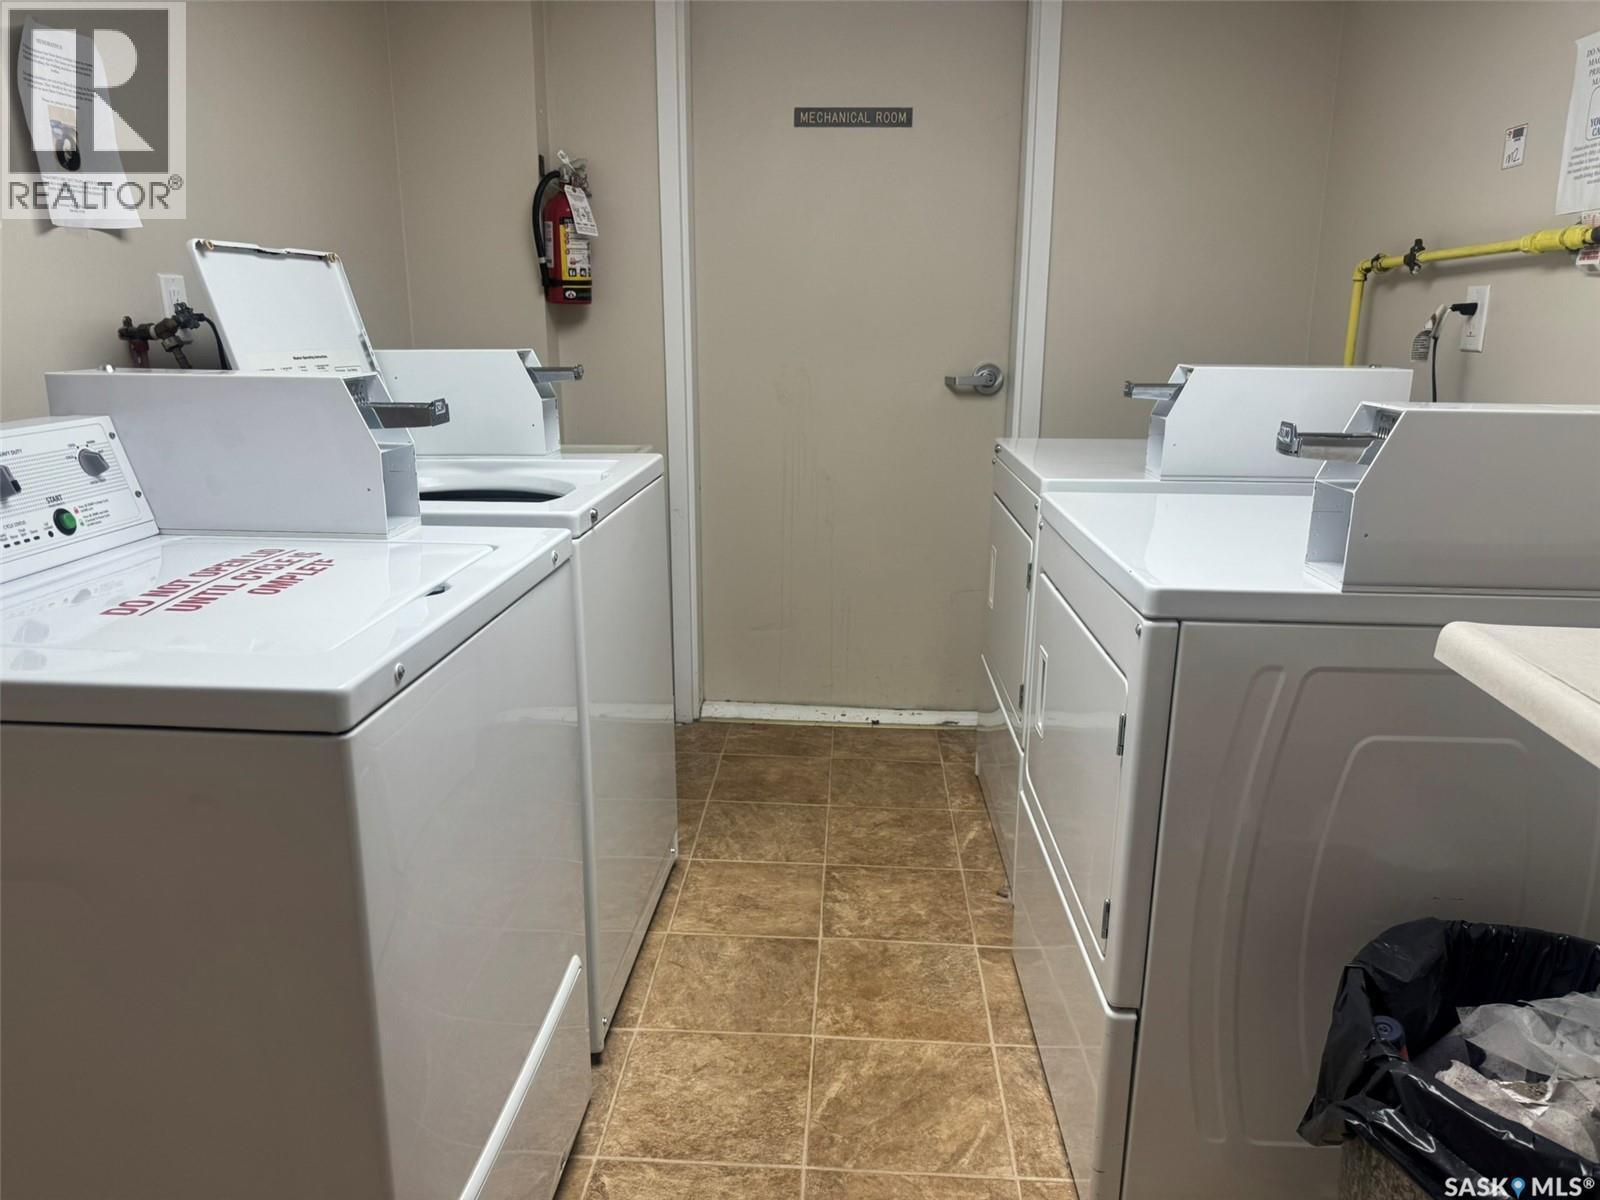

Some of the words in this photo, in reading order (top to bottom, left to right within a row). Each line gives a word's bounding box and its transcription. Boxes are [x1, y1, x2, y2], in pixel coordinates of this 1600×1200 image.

[800, 111, 870, 123] MECHANICAL
[876, 111, 907, 123] ROOM
[46, 494, 63, 504] START
[99, 600, 155, 616] DO
[139, 579, 201, 597] NOT
[188, 559, 256, 577] OPEN
[240, 548, 285, 558] LID
[164, 583, 248, 612] UNTIL
[230, 559, 304, 581] CYCLE
